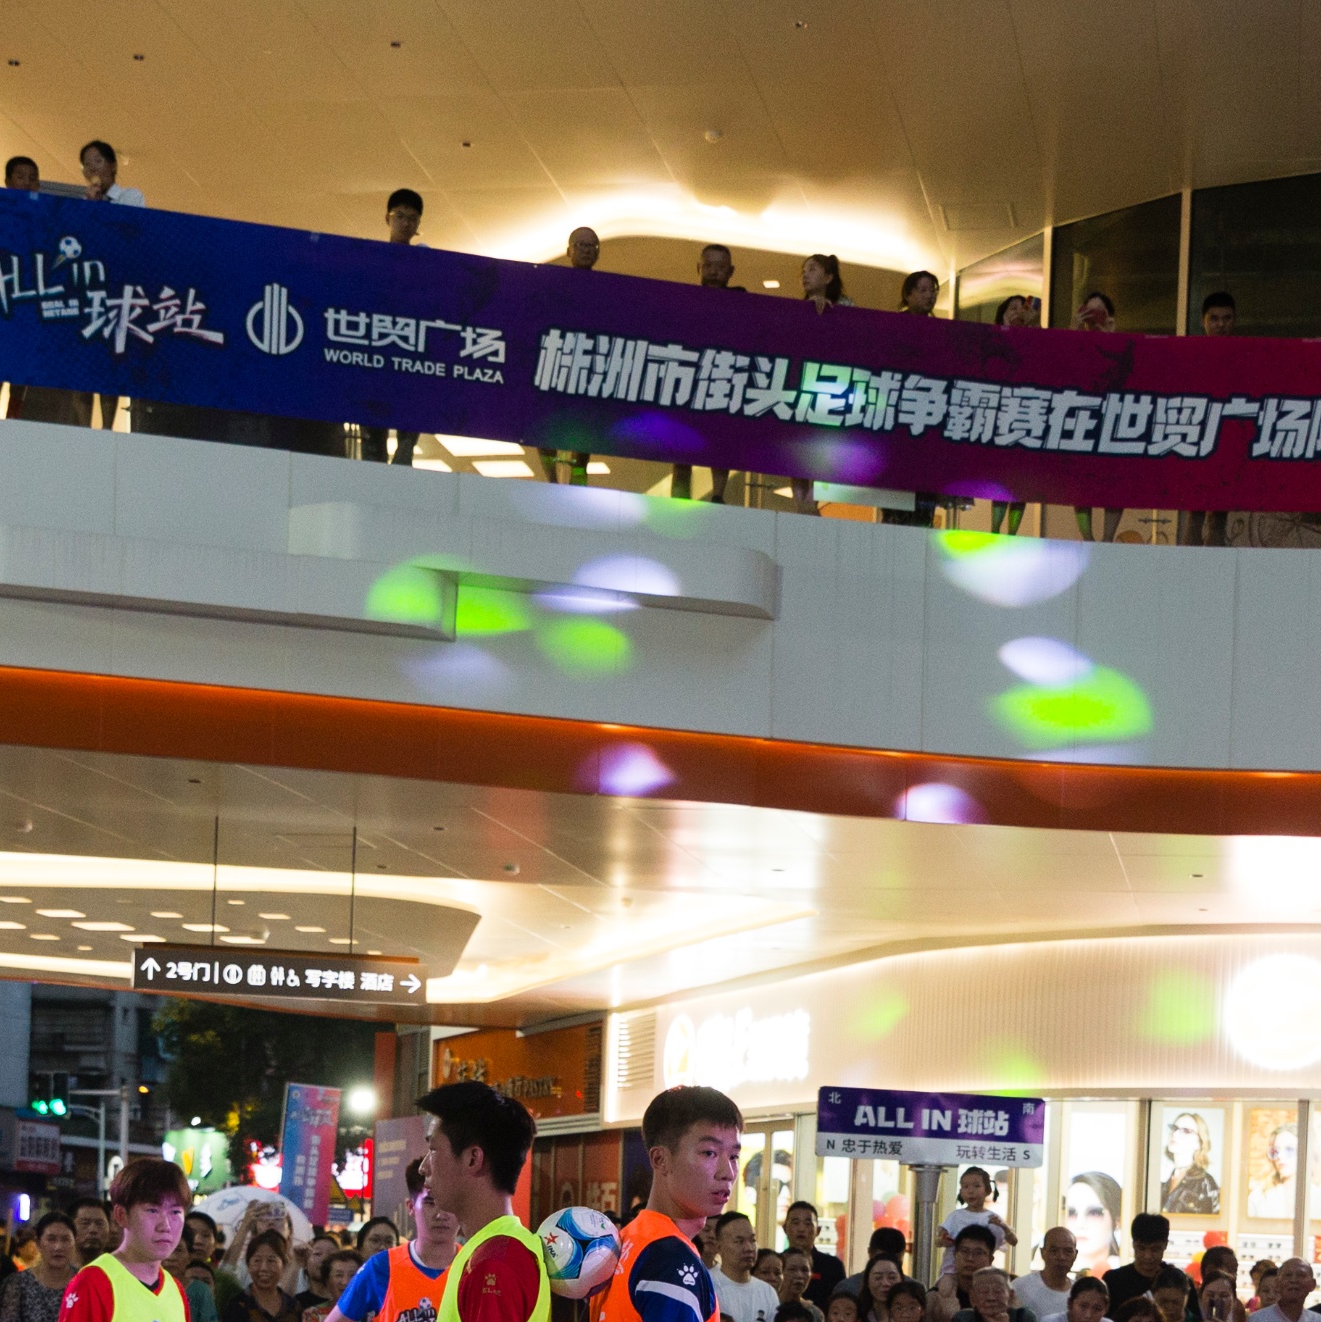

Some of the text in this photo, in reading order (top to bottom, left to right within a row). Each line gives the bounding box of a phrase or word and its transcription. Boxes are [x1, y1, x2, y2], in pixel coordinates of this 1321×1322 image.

[81, 285, 225, 354] 球站
[324, 306, 507, 364] 世贸广场
[324, 349, 504, 384] WORLD TRADE PLAZA
[166, 961, 211, 983] 2号门
[828, 1092, 841, 1105] 北
[1022, 1102, 1035, 1115] 南
[854, 1105, 1009, 1136] ALL IN 球站
[826, 1139, 903, 1156] N 忠于热爱
[955, 1144, 1031, 1161] 玩转生活 S
